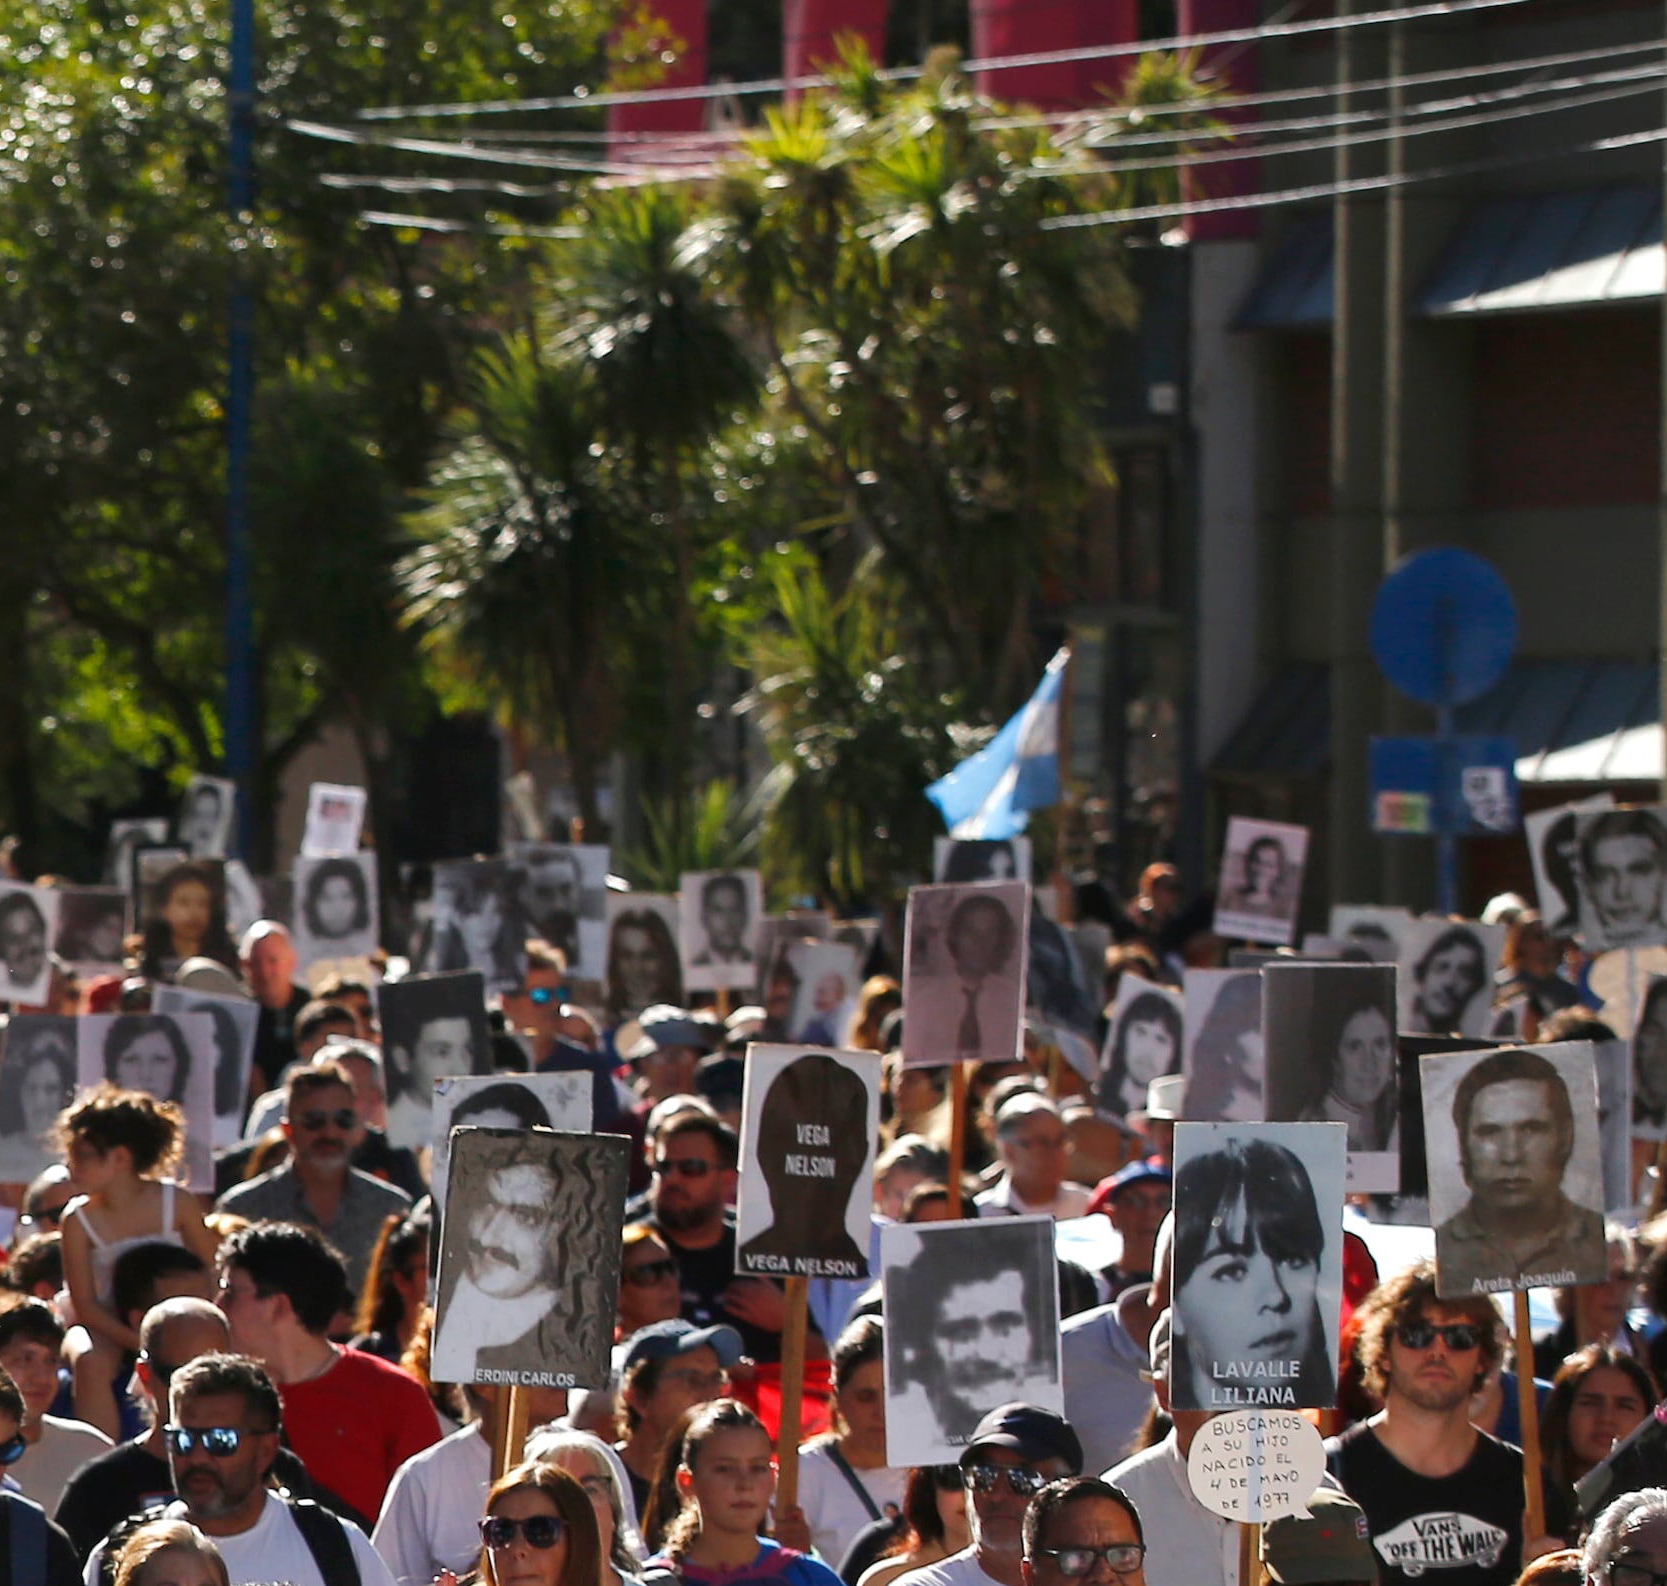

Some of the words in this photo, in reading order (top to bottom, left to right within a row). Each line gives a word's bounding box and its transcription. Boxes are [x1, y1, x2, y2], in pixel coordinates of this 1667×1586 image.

[796, 1123, 831, 1148] VEGA
[785, 1154, 836, 1179] NELSON
[745, 1253, 791, 1273] VEGA
[795, 1256, 858, 1278] NELSON
[473, 1368, 519, 1385] ERDINI
[521, 1370, 576, 1387] CARLOS
[1212, 1359, 1300, 1379] LAVALLE
[1210, 1386, 1296, 1405] LILIANA
[1212, 1416, 1302, 1436] BUSCAMOS
[1202, 1443, 1212, 1454] A
[1223, 1438, 1243, 1451] SU
[1256, 1435, 1289, 1448] HIJO
[1202, 1454, 1266, 1474] NACIDO
[1276, 1453, 1292, 1465] EL
[1230, 1477, 1248, 1489] DE
[1260, 1469, 1299, 1485] MAYO
[1222, 1499, 1239, 1510] DE
[1254, 1492, 1290, 1510] 1977
[1411, 1513, 1463, 1538] VANS
[1421, 1531, 1458, 1563] THE
